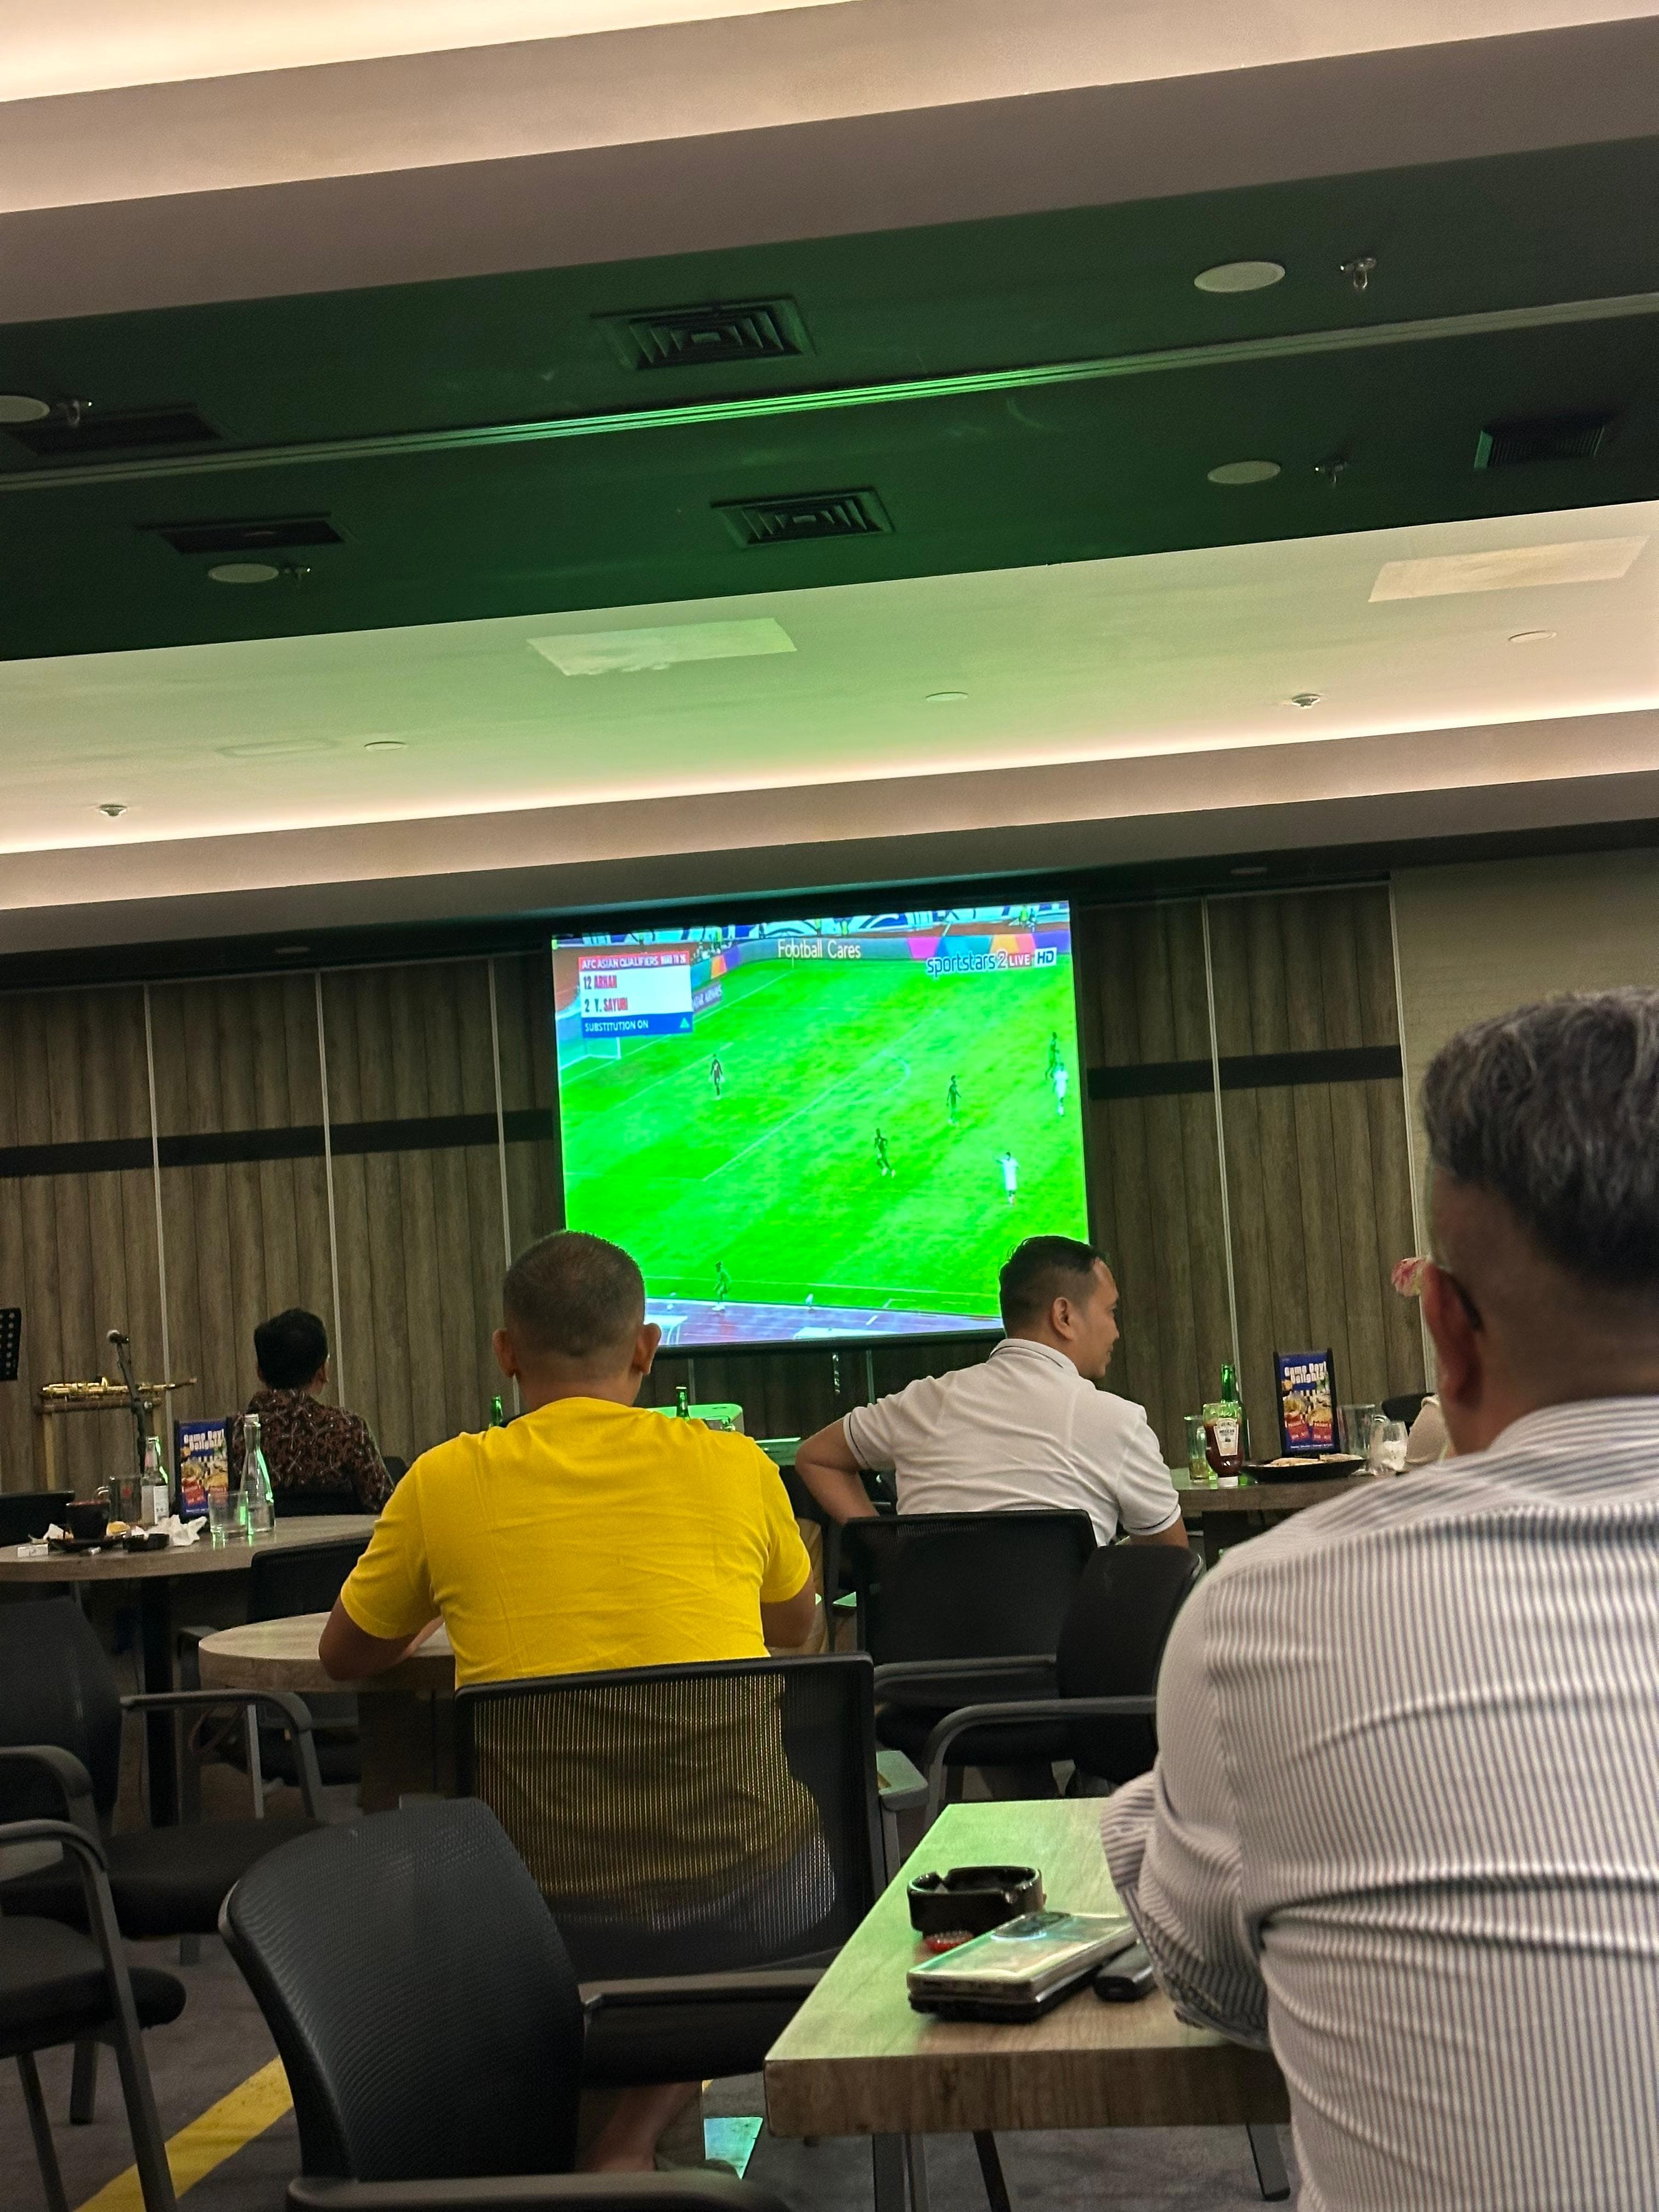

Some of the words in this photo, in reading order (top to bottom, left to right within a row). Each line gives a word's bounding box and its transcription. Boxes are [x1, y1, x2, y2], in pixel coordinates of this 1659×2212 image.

[777, 939, 823, 958] Football
[827, 939, 861, 959] Cares
[582, 960, 596, 969] AFC
[597, 958, 619, 968] ASIAN
[619, 955, 658, 967] QUALIFIERS
[927, 952, 996, 978] sportstars
[997, 951, 1006, 969] 2
[1008, 954, 1031, 967] LIVE
[1037, 950, 1054, 964] HD
[584, 976, 592, 990] 12
[594, 974, 617, 989] ARHAN
[585, 1000, 590, 1012] 2
[594, 998, 602, 1012] Y.
[604, 997, 628, 1012] SAYURI
[585, 1021, 636, 1032] SUBSTITUTION
[637, 1020, 649, 1029] ON
